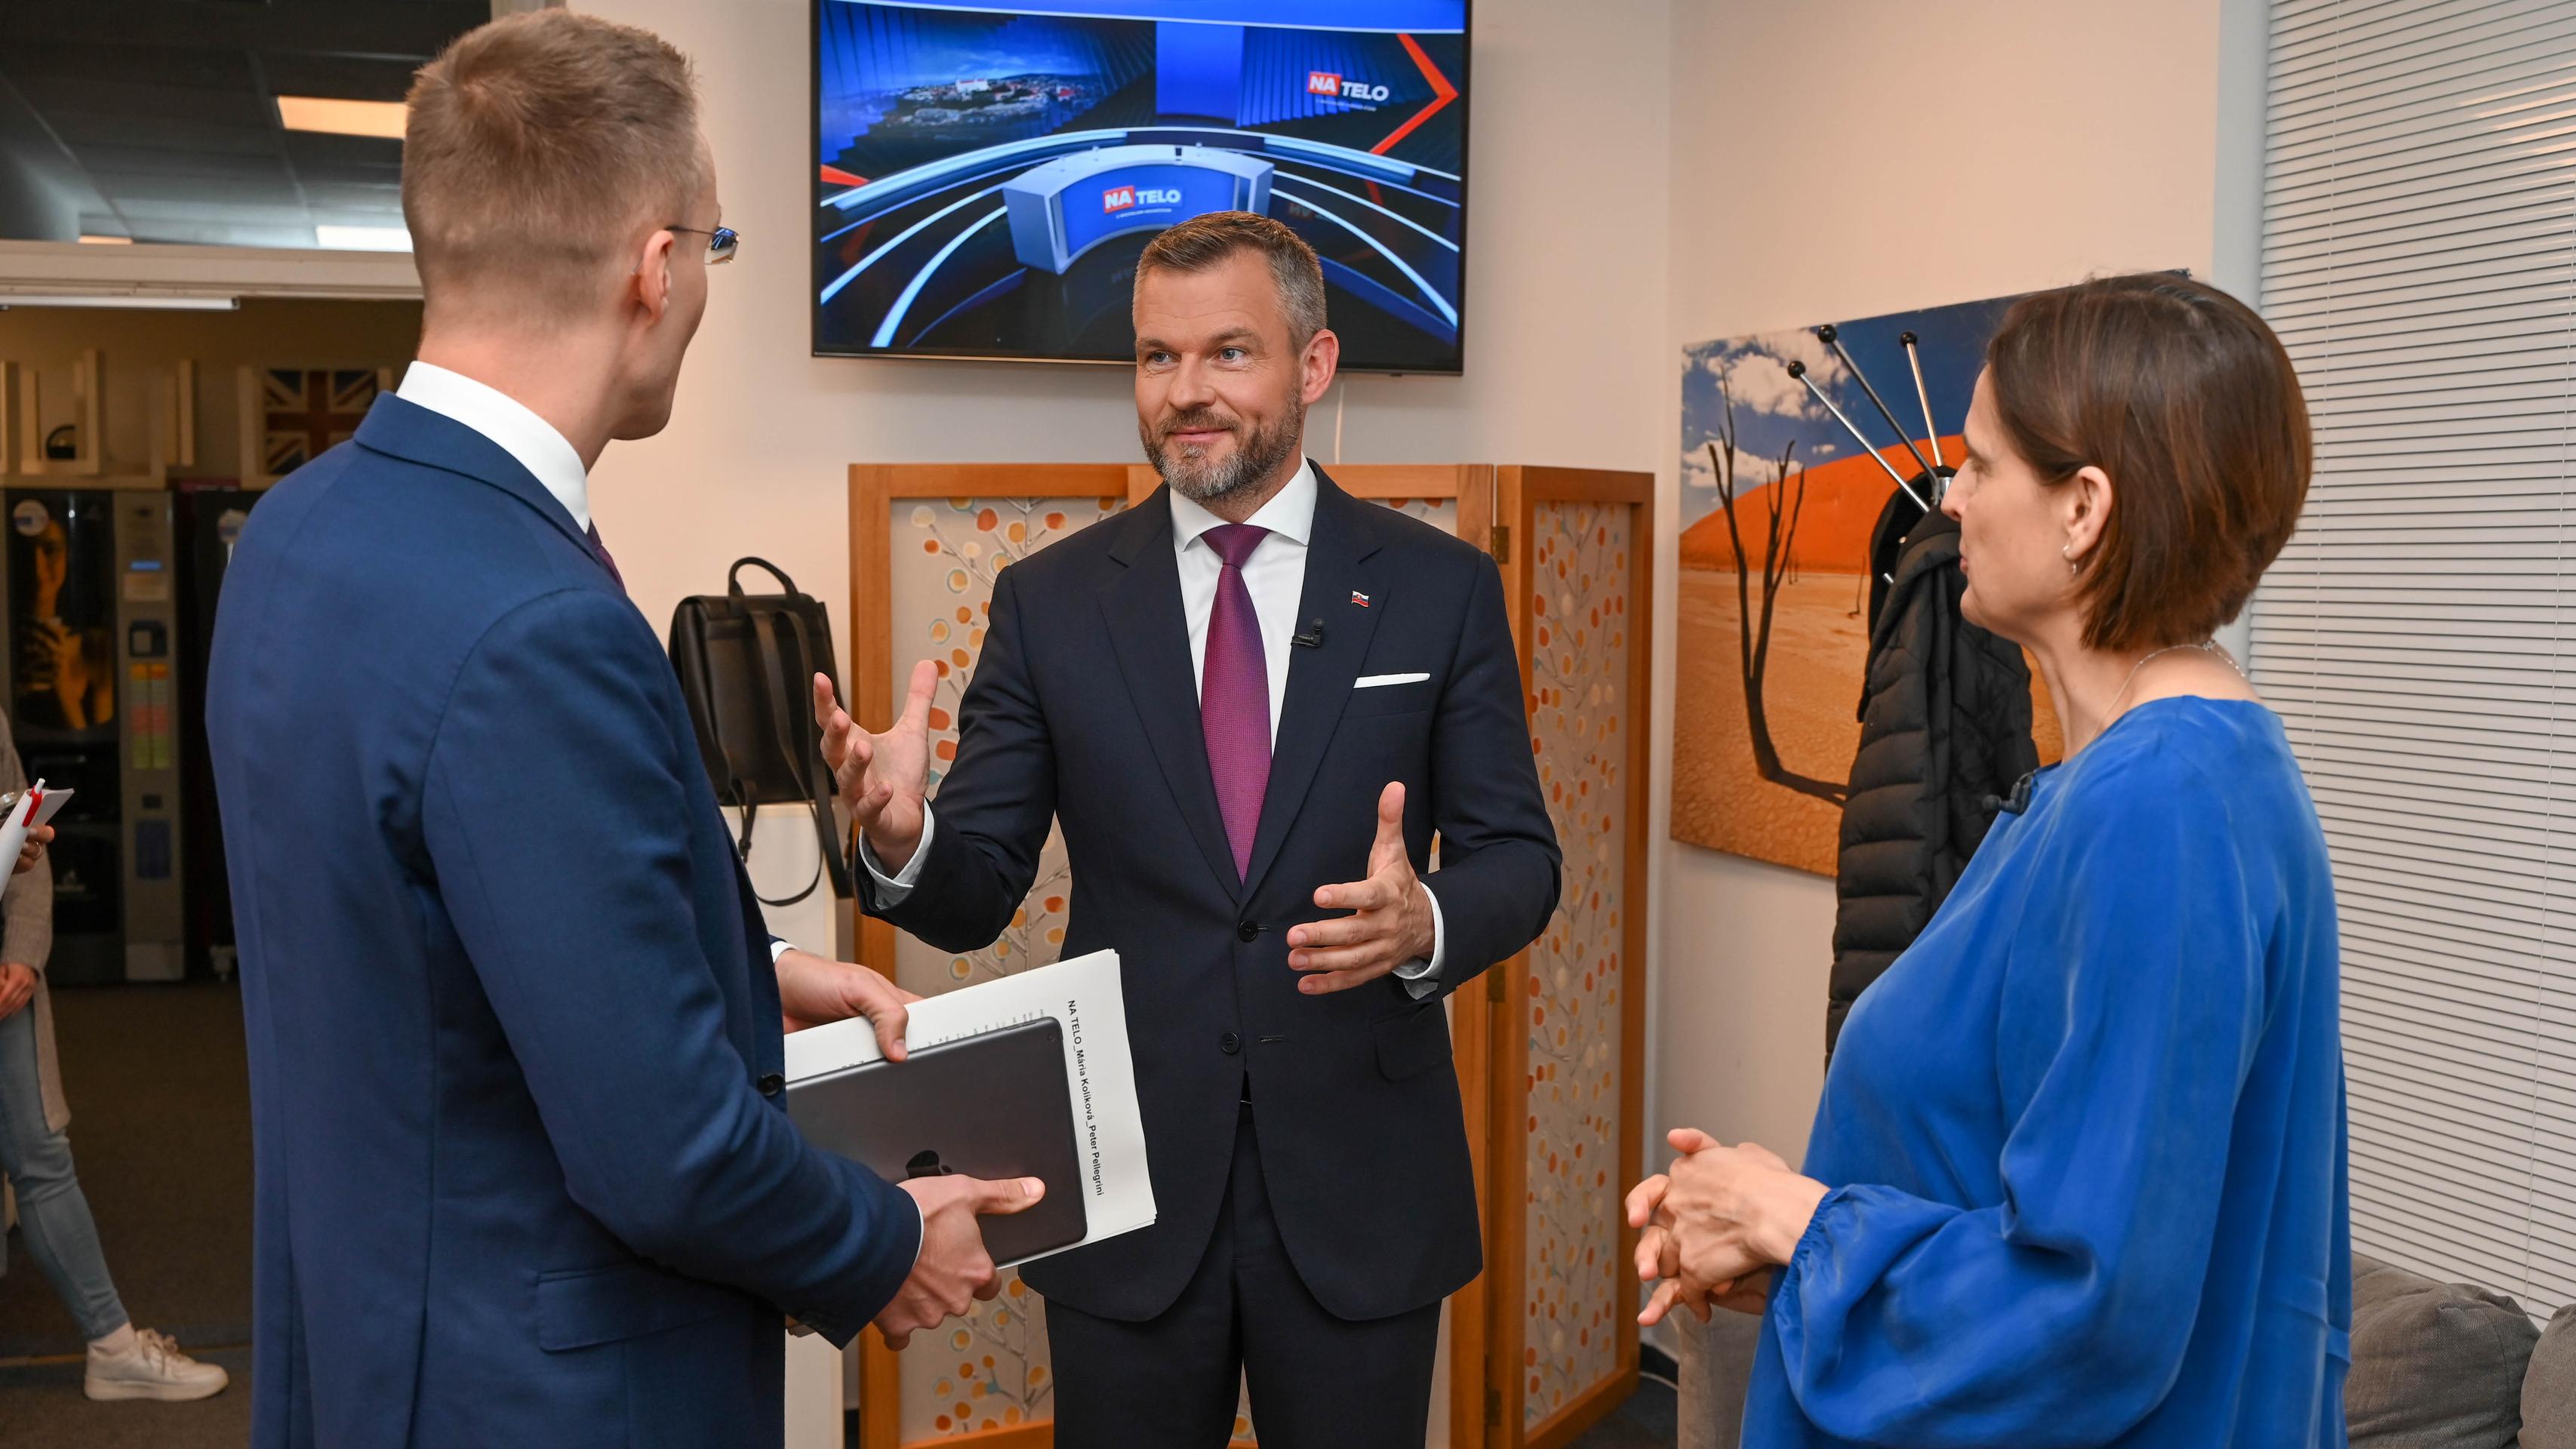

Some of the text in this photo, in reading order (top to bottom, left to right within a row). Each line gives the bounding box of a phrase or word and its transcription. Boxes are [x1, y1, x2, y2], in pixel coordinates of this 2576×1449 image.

[1309, 75, 1389, 101] NA TELO
[1104, 189, 1181, 209] NA TELO
[1068, 1000, 1076, 1015] NA
[1092, 1152, 1104, 1196] Pellegrini
